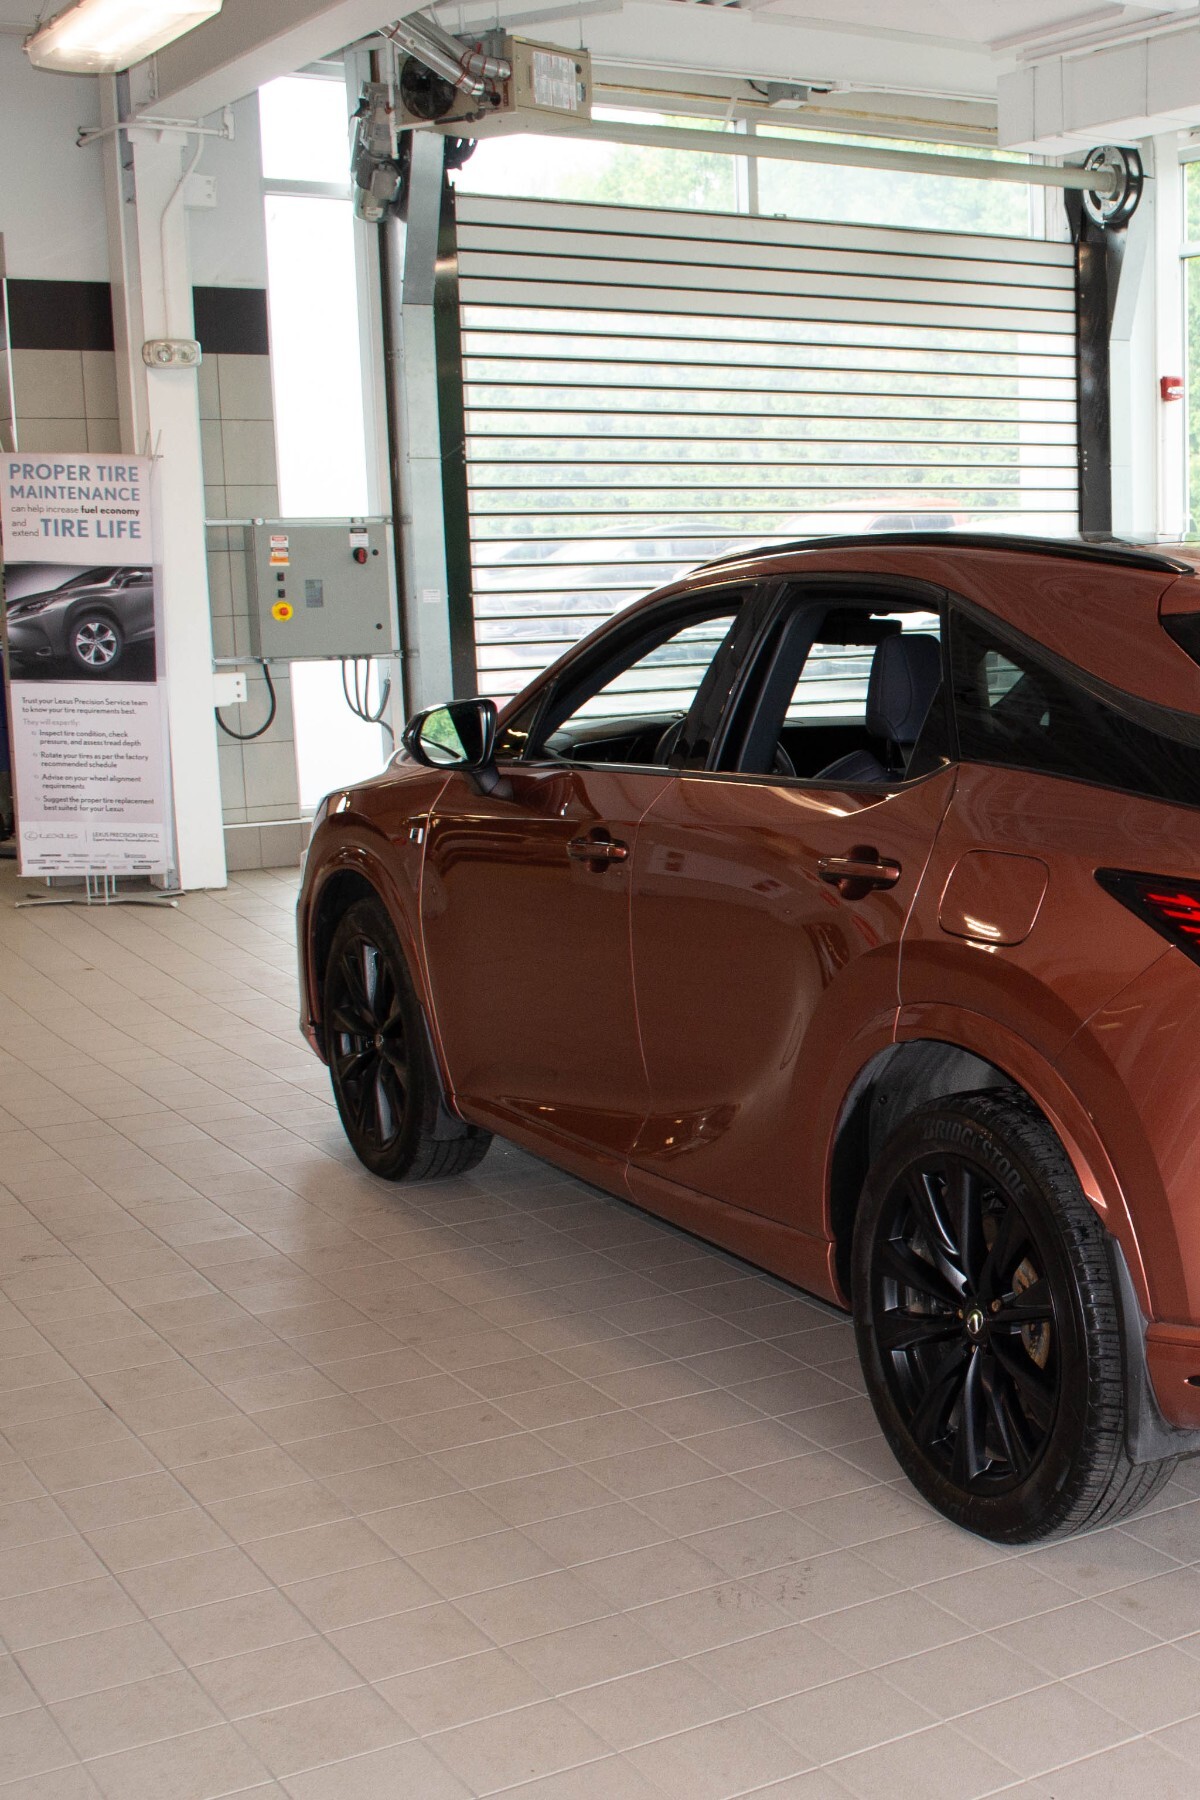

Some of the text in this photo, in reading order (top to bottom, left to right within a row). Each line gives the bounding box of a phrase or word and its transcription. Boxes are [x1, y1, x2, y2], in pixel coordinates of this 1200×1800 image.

[9, 463, 139, 482] PROPER TIRE
[10, 485, 140, 501] MAINTENANCE
[27, 505, 44, 514] help
[46, 505, 79, 514] increase
[81, 505, 98, 514] fuel
[100, 507, 140, 516] economy
[11, 519, 27, 527] and
[40, 518, 141, 538] TIRE LIFE
[11, 529, 39, 537] extend
[22, 697, 38, 705] Trust
[40, 751, 61, 759] Rotate
[125, 753, 149, 761] factory
[109, 775, 142, 783] alignment
[43, 795, 68, 804] Suggest
[115, 797, 154, 805] replacement
[923, 1117, 1029, 1196] BRIDGESTONE
